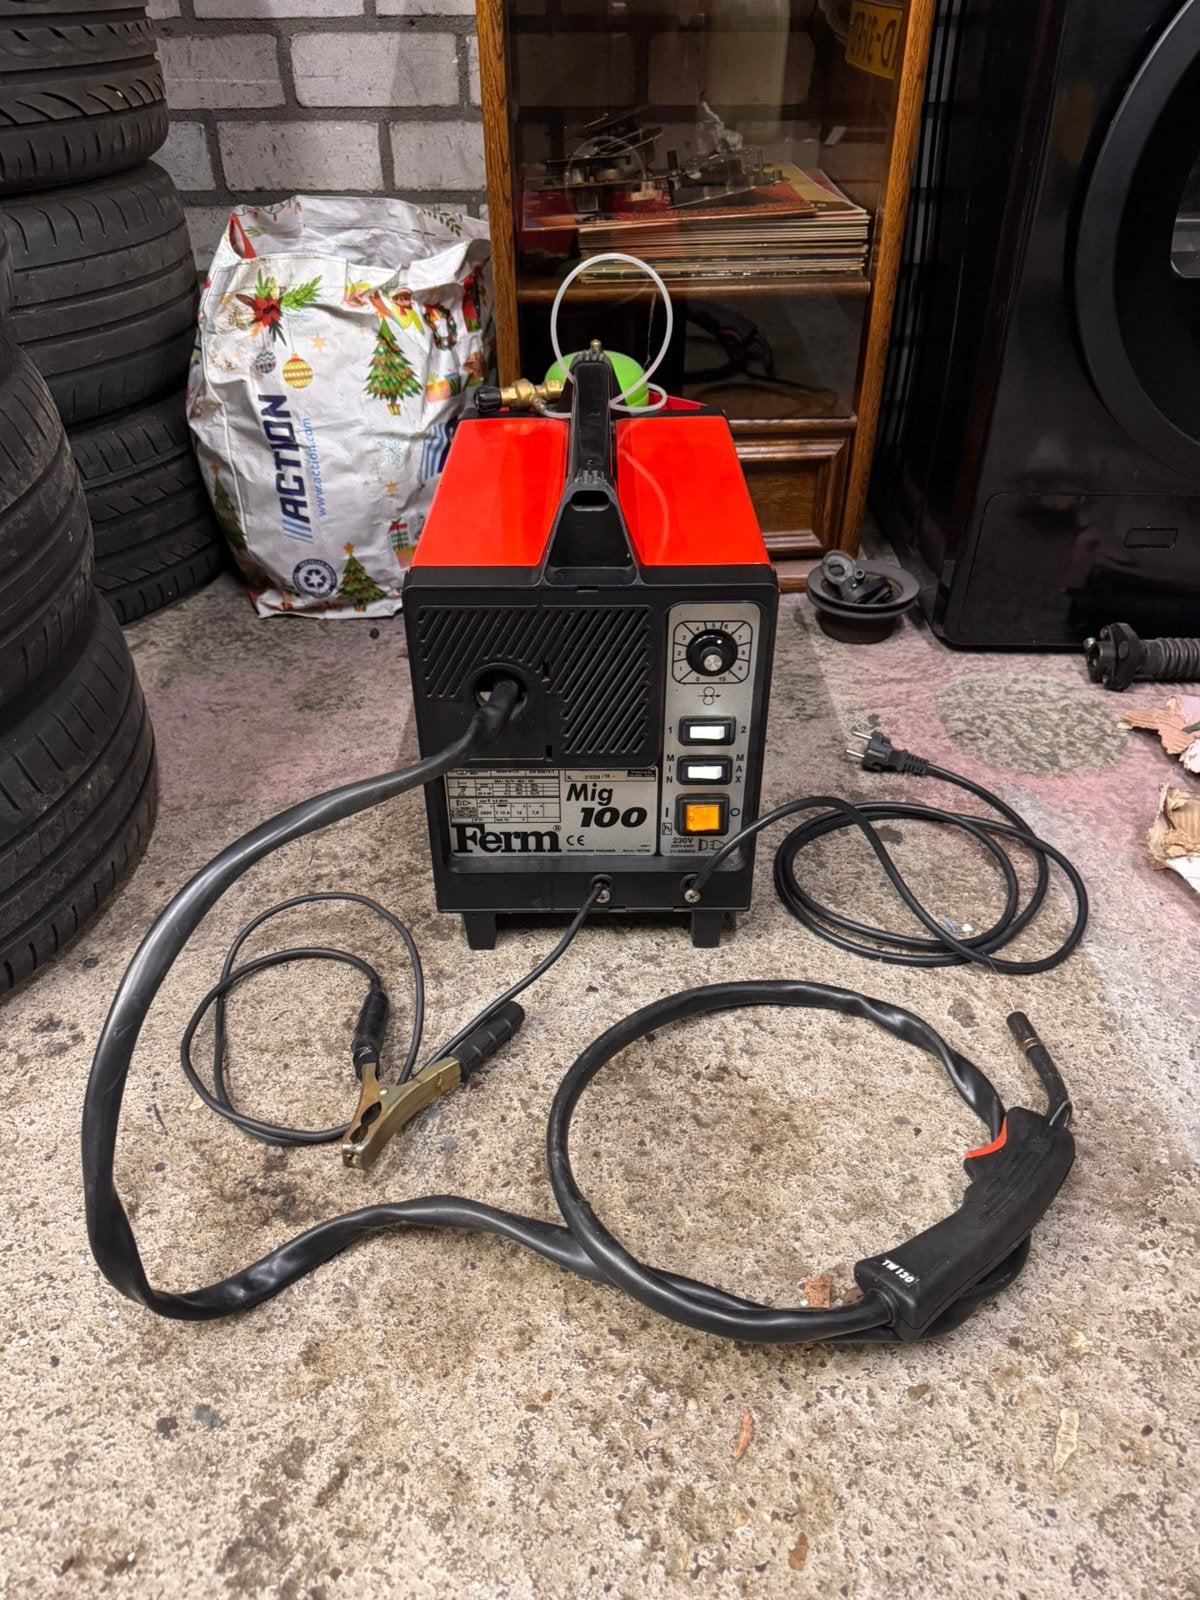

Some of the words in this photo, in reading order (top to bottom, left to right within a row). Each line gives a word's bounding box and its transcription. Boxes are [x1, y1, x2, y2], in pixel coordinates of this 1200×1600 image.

[258, 394, 311, 525] ACTION
[303, 417, 328, 517] www.action.com
[666, 754, 674, 783] MIN
[736, 754, 744, 783] MAX
[566, 783, 613, 806] Mig
[581, 807, 648, 828] 100
[451, 823, 562, 853] Ferm
